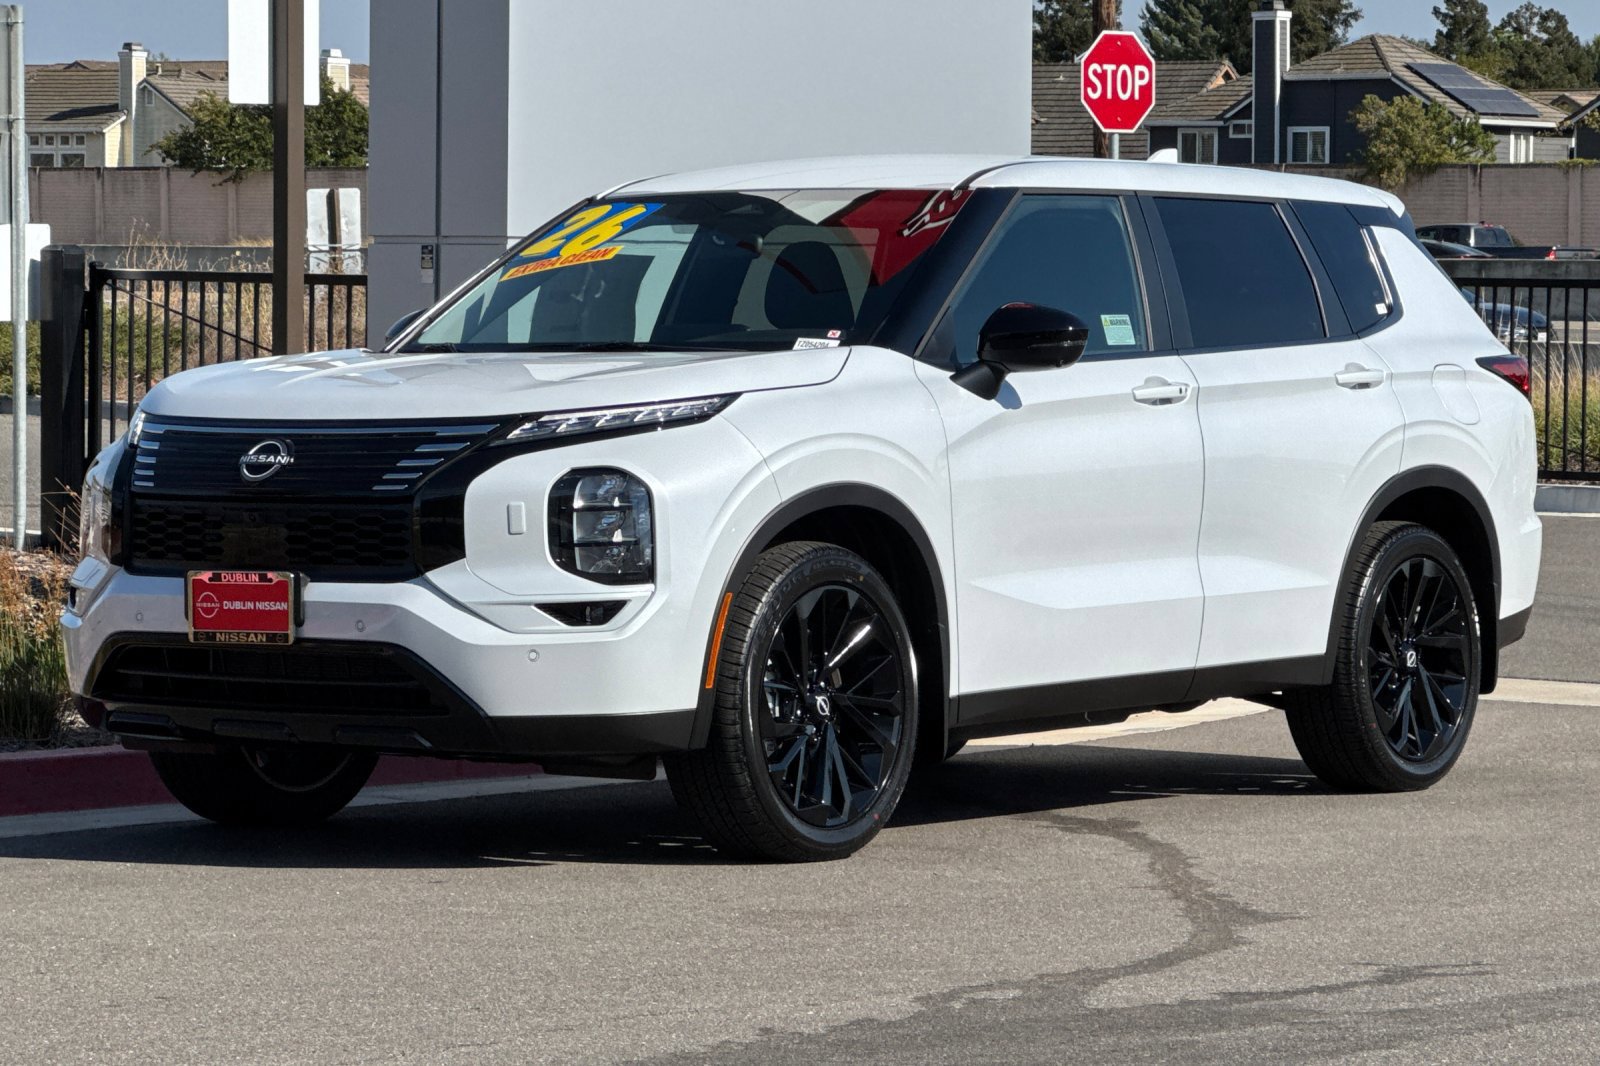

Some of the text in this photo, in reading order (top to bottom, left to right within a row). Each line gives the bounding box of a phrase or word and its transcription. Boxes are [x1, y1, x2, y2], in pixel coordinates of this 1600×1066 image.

[1087, 63, 1149, 100] STOP
[519, 204, 647, 257] 26
[508, 247, 618, 278] EXTRA CLEAN
[240, 454, 289, 463] NISSAN
[221, 573, 259, 582] DUBLIN
[223, 601, 288, 611] DUBLIN NISSAN
[216, 632, 267, 642] NISSAN
